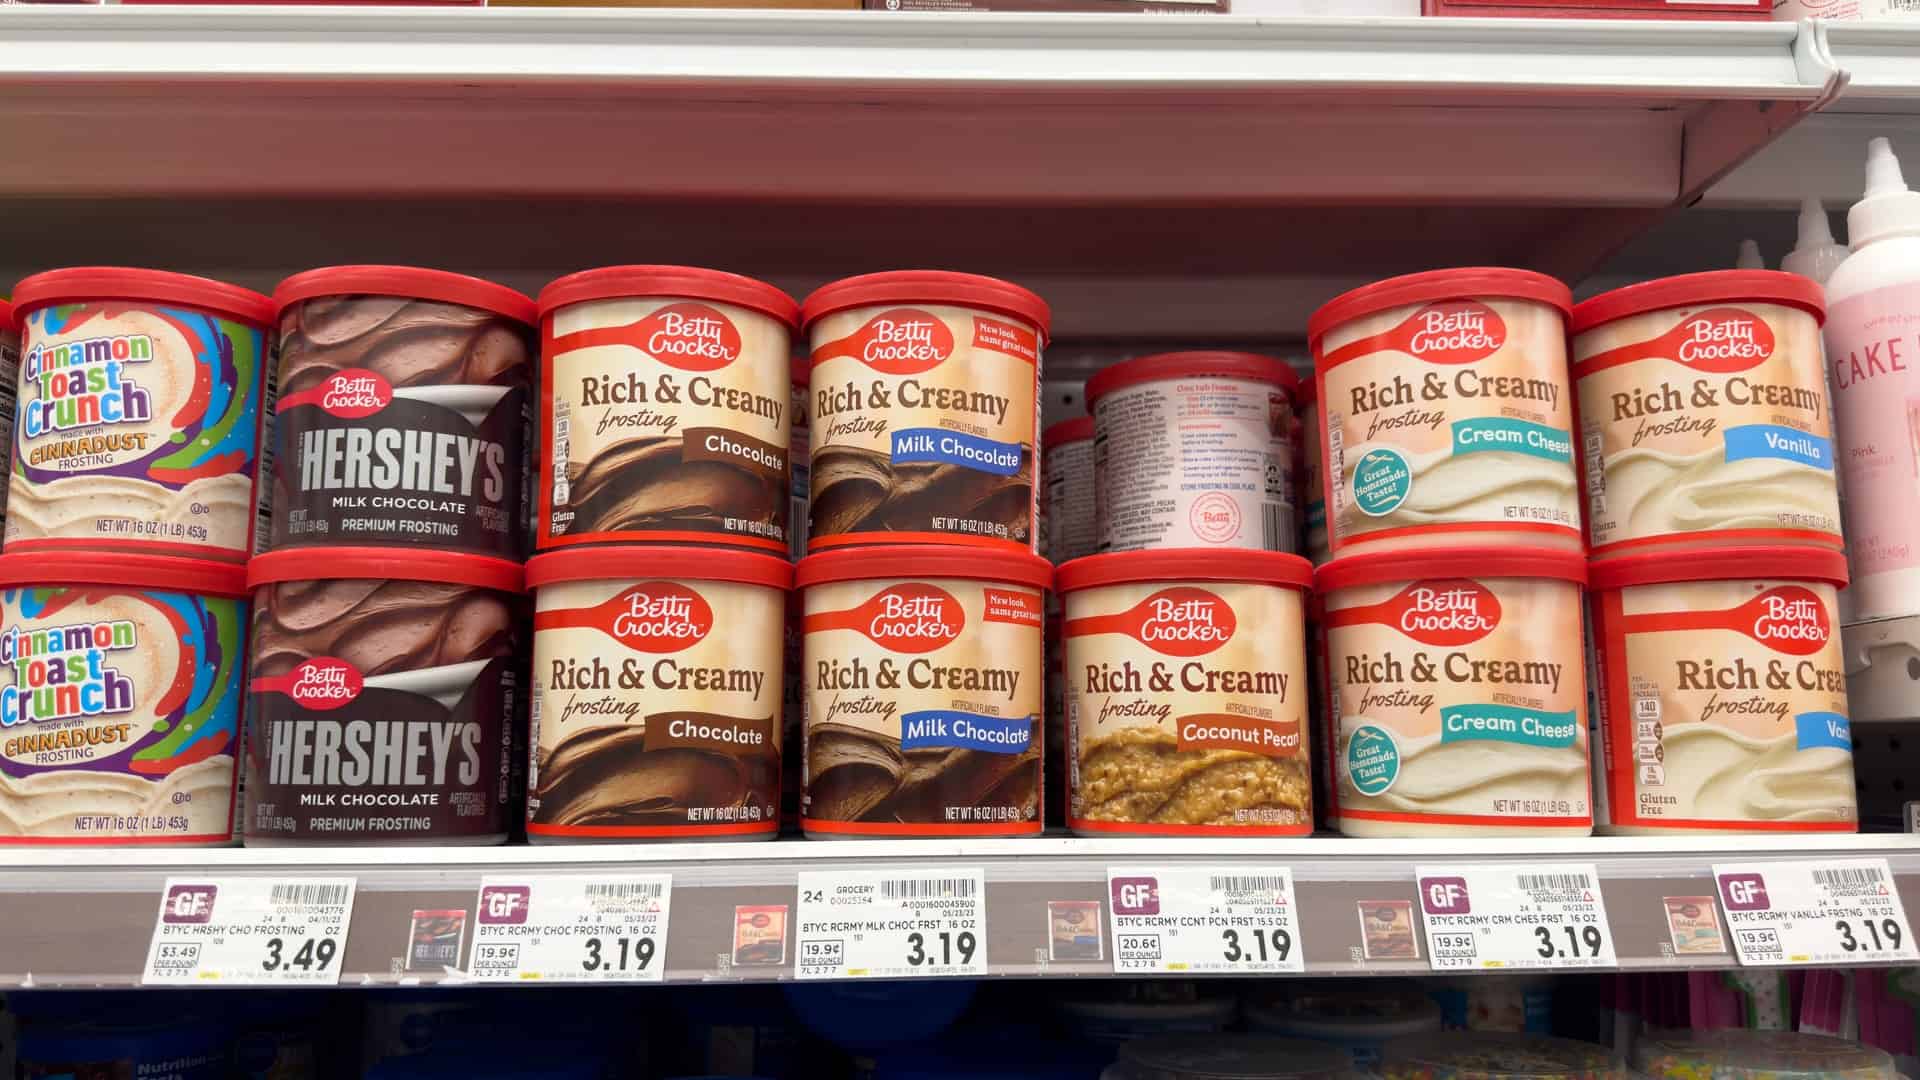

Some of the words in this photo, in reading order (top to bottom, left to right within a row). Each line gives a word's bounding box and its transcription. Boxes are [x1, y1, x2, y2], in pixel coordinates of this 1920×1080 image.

[659, 313, 723, 339] Betty
[873, 320, 933, 345] Betty
[1418, 310, 1483, 334] Betty
[1686, 320, 1752, 345] Betty
[649, 331, 734, 360] Crocker
[864, 339, 945, 360] Crocker
[1411, 331, 1500, 353] Crocker
[1680, 338, 1769, 362] Crocker
[27, 336, 151, 380] Cinnamon
[1835, 338, 1906, 390] CAKE
[40, 361, 121, 401] Toast
[331, 377, 376, 400] Betty
[1351, 375, 1413, 415] Rich
[1421, 372, 1448, 401] &
[1455, 369, 1559, 411] Creamy
[26, 382, 149, 436] Crunch
[324, 392, 385, 409] Crocker
[582, 373, 646, 406] Rich
[655, 374, 681, 403] &
[688, 377, 782, 429] Creamy
[817, 381, 861, 418] Rich
[868, 380, 891, 408] &
[898, 380, 1009, 425] Creamy
[1611, 382, 1683, 422] Rich
[1691, 379, 1719, 408] &
[1726, 378, 1821, 420] Creamy
[596, 408, 677, 435] frosting
[825, 418, 887, 444] frosting
[1367, 410, 1444, 440] frosting
[1632, 416, 1716, 447] frosting
[1459, 428, 1522, 444] Cream
[1765, 432, 1820, 458] Vanilla
[30, 433, 148, 465] CINNADUST
[705, 436, 782, 470] Chocolate
[897, 438, 935, 453] Milk
[941, 439, 1018, 467] Chocolate
[59, 454, 113, 470] FROSTING
[302, 428, 504, 502] HERSHEY'S
[1364, 466, 1390, 482] Great
[1356, 469, 1407, 497] Homemade
[1367, 483, 1397, 501] Taste!
[333, 497, 366, 507] MILK
[372, 497, 465, 514] CHOCOLATE
[97, 520, 113, 533] NET
[115, 521, 129, 533] WT
[133, 522, 143, 534] 16
[145, 522, 157, 535] OZ
[160, 521, 169, 536] (1
[171, 522, 185, 537] LB)
[187, 526, 207, 541] 453g
[342, 519, 395, 532] PREMIUM
[399, 520, 458, 535] FROSTING
[624, 593, 692, 621] Betty
[880, 594, 944, 621] Betty
[1149, 598, 1214, 625] Betty
[1409, 588, 1477, 616] Betty
[1762, 596, 1816, 623] Betty
[613, 613, 704, 637] Crocker
[870, 614, 956, 638] Crocker
[1141, 618, 1227, 641] Crocker
[1401, 607, 1494, 631] Crocker
[1755, 616, 1826, 641] Crocker
[1, 622, 134, 662] Cinnamon
[16, 648, 103, 690] Toast
[300, 665, 347, 688] Betty
[551, 657, 610, 690] Rich
[618, 658, 644, 689] &
[653, 658, 764, 701] Creamy
[817, 658, 869, 690] Rich
[876, 659, 900, 688] &
[908, 659, 1019, 700] Creamy
[1346, 652, 1403, 684] Rich
[1411, 653, 1437, 682] &
[1445, 652, 1561, 693] Creamy
[1677, 658, 1759, 690] Rich
[1766, 660, 1790, 690] &
[293, 681, 356, 699] Crocker
[1086, 661, 1141, 693] Rich
[1149, 662, 1173, 692] &
[1181, 662, 1288, 703] Creamy
[1, 672, 131, 725] Crunch
[561, 693, 640, 722] frosting
[827, 693, 896, 720] frosting
[1099, 696, 1171, 723] frosting
[1360, 687, 1434, 714] frosting
[1701, 694, 1789, 722] frosting
[669, 720, 762, 744] Chocolate
[908, 719, 946, 739] Milk
[953, 721, 1028, 744] Chocolate
[1184, 724, 1258, 743] Coconut
[1264, 729, 1298, 746] Pecan
[1448, 714, 1515, 732] Cream
[1521, 718, 1574, 737] Cheese
[5, 725, 129, 757] CINNADUST
[270, 721, 481, 786] HERSHEY'S
[36, 748, 94, 763] FROSTING
[301, 794, 335, 806] MILK
[341, 794, 439, 806] CHOCOLATE
[1640, 794, 1677, 805] Gluten
[1640, 804, 1662, 815] Free
[310, 819, 365, 831] PREMIUM
[369, 817, 430, 830] FROSTING
[804, 890, 823, 903] 24
[837, 886, 874, 894] GROCERY
[1121, 885, 1149, 908] GF
[1430, 884, 1460, 907] GF
[1729, 880, 1756, 904] GF
[175, 892, 208, 916] GF
[488, 893, 520, 917] GF
[481, 926, 505, 936] BTYC
[508, 926, 541, 936] RCRMY
[544, 926, 571, 935] CHOC
[574, 926, 622, 935] FROSTING
[630, 926, 638, 934] 16
[643, 926, 656, 934] OZ
[803, 923, 827, 932] BTYC
[830, 922, 863, 932] RCRMY
[866, 921, 885, 931] MLK
[889, 921, 915, 930] CHOC
[918, 920, 940, 929] FRST
[949, 920, 958, 928] 16
[962, 920, 975, 928] OZ
[1118, 918, 1142, 927] BTYC
[1145, 918, 1177, 926] RCRMY
[1181, 917, 1205, 926] CCNT
[1209, 918, 1228, 926] PCN
[1231, 917, 1253, 926] FRST
[1257, 918, 1273, 926] 15.5
[1276, 917, 1288, 926] OZ
[1431, 917, 1454, 926] BTYC
[1457, 916, 1489, 925] RCRMY
[1492, 915, 1512, 924] CRM
[1515, 915, 1538, 924] CHES
[1541, 915, 1563, 923] FRST
[1571, 915, 1581, 923] 16
[1583, 914, 1596, 922] OZ
[1123, 939, 1157, 949] 20.6¢
[1222, 929, 1291, 962] 3.19
[1437, 937, 1470, 947] 19.9¢
[1535, 926, 1601, 958] 3.19
[1742, 932, 1775, 943] 19.9¢
[1836, 919, 1901, 952] 3.19
[161, 947, 196, 958] $3.49
[263, 938, 336, 971] 3.49
[481, 947, 516, 958] 19.9¢
[582, 937, 655, 971] 3.19
[805, 944, 839, 955] 19.9¢
[907, 932, 976, 966] 3.19
